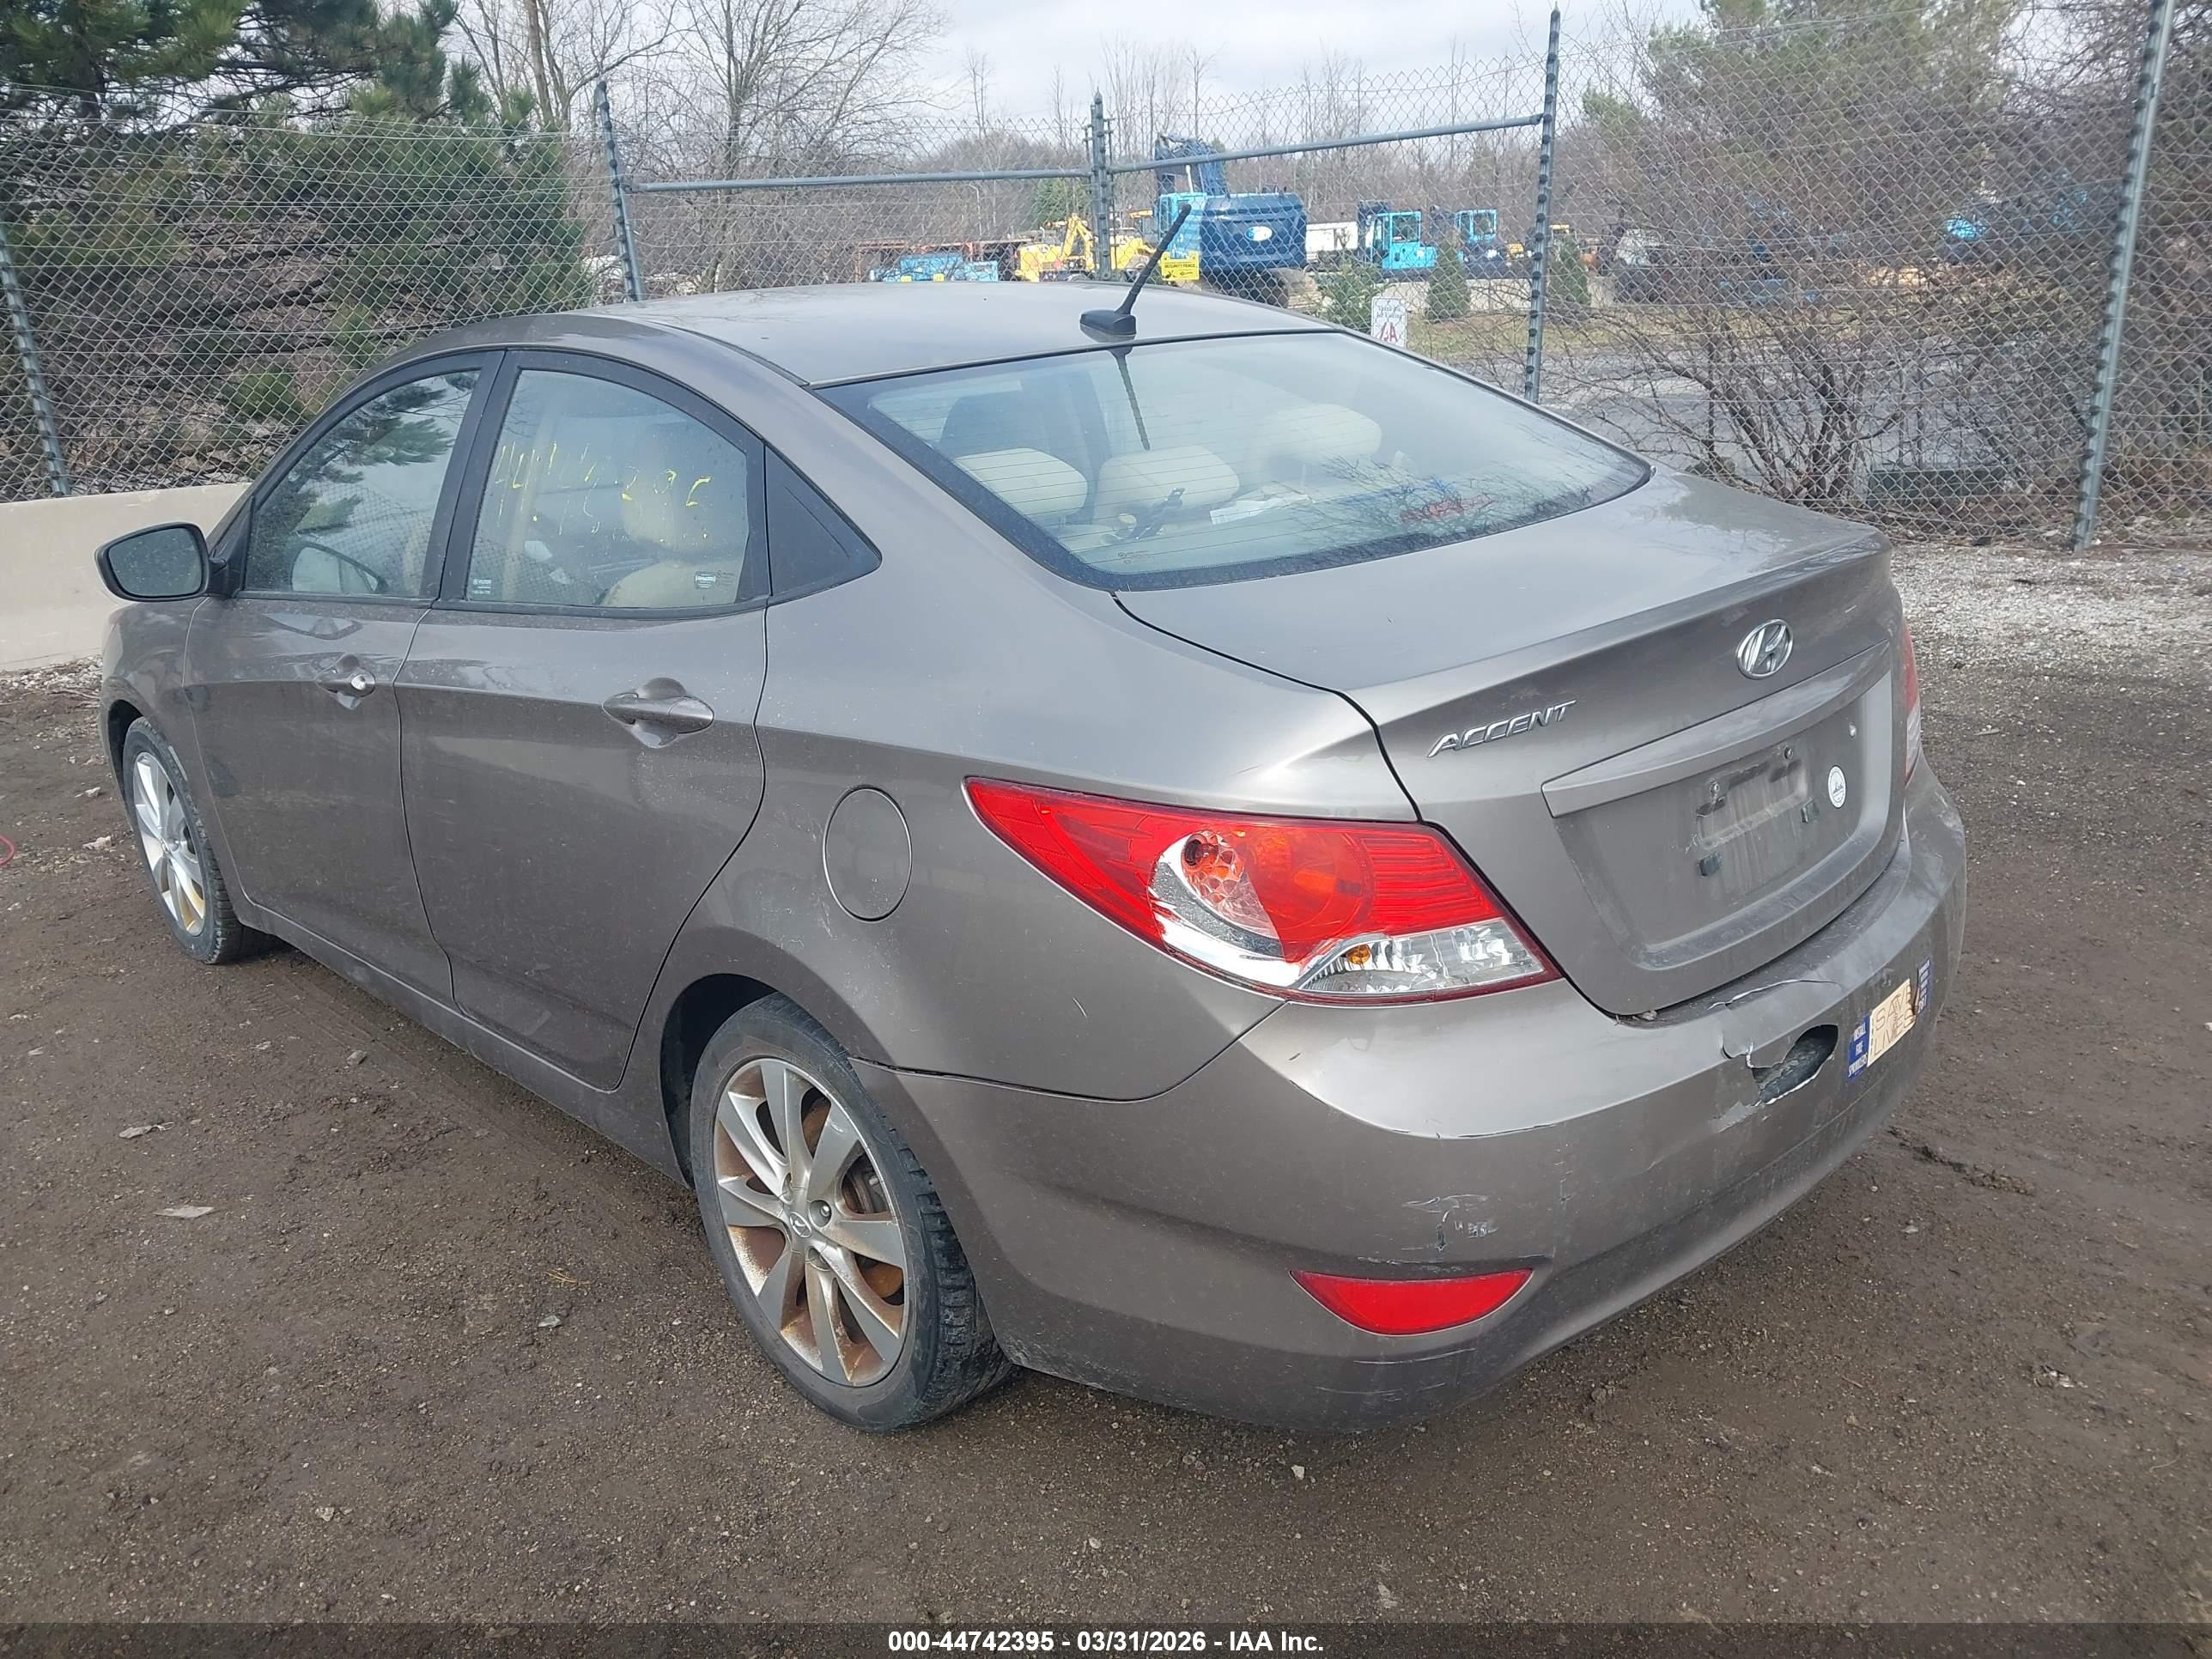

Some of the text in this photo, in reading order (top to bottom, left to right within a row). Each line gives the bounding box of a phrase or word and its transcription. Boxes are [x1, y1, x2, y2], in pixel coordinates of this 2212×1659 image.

[1425, 699, 1577, 759] ACCENT
[1874, 1008, 1914, 1056] LIVES
[1875, 984, 1911, 1032] SAVE
